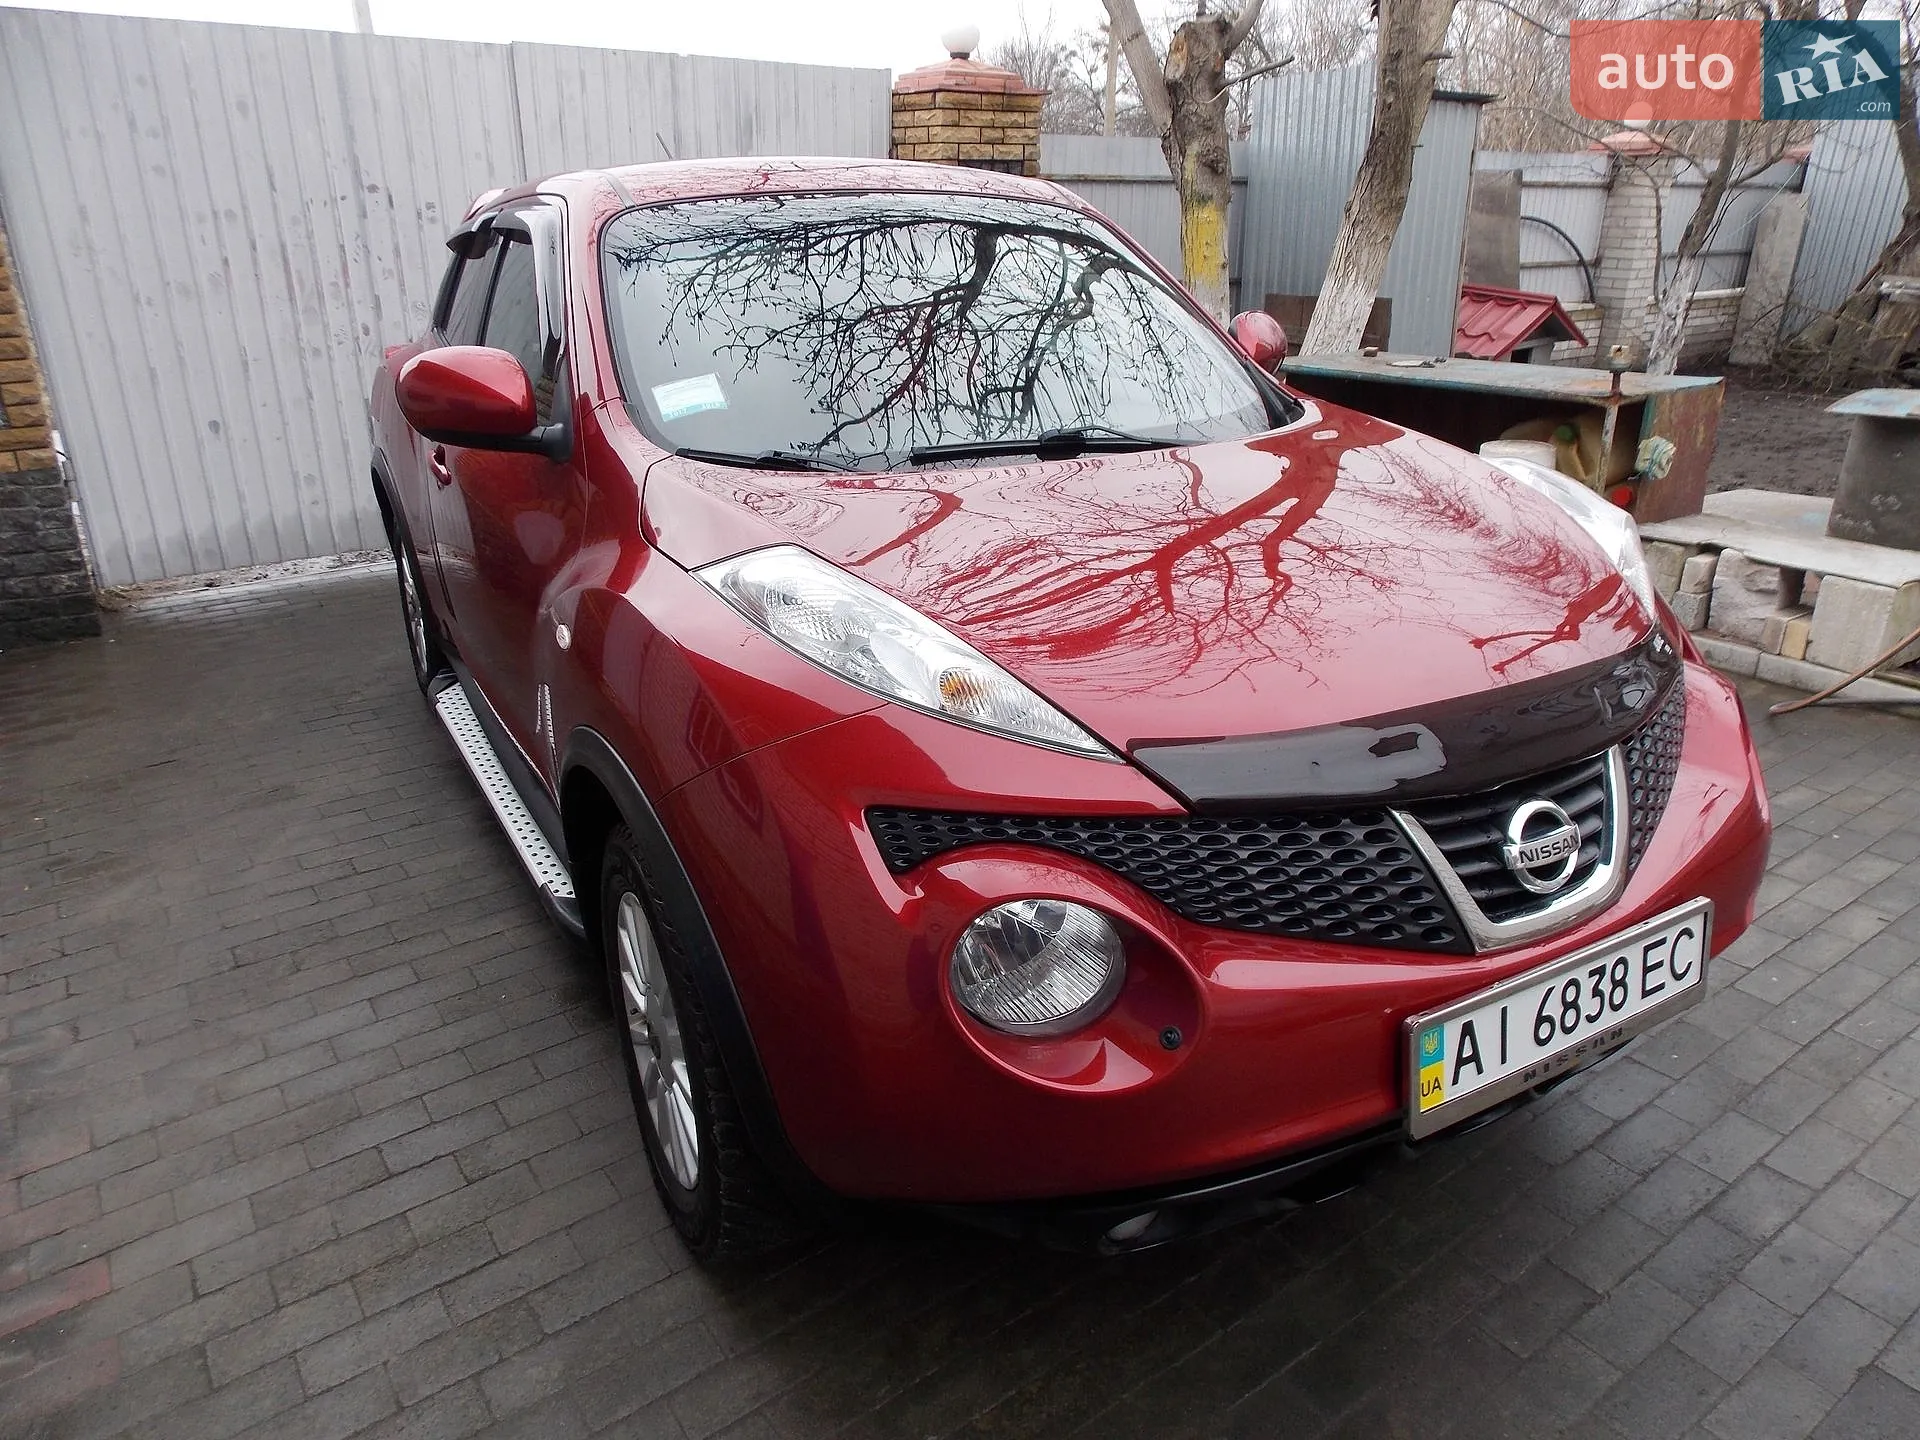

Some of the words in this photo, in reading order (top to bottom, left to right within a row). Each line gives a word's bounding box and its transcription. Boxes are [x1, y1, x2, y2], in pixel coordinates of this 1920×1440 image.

[1519, 830, 1579, 864] NISSAN
[1533, 956, 1629, 1047] 6838
[1640, 927, 1695, 1000] EC
[1523, 1027, 1624, 1083] NISSAN
[1421, 1076, 1442, 1098] UA
